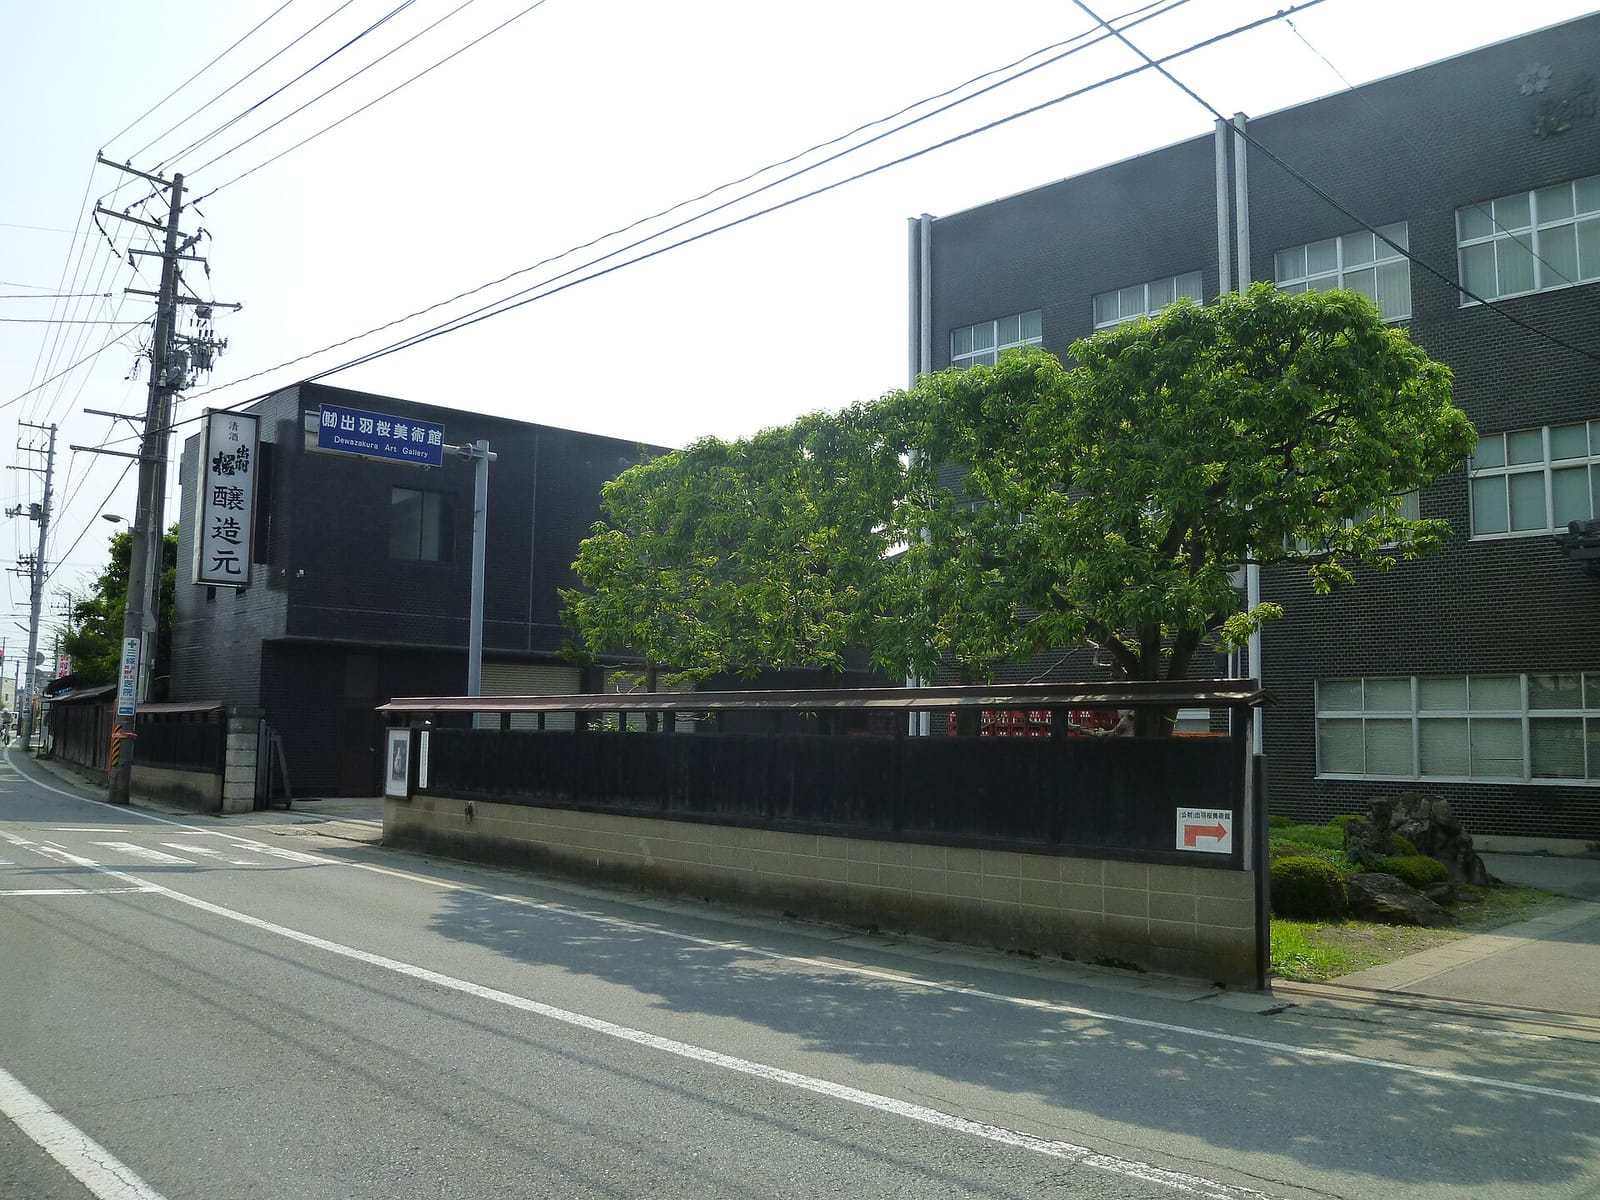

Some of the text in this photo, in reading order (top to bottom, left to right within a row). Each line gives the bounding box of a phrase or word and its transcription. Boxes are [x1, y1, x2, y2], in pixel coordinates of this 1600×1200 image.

[228, 421, 239, 442] 清酒
[334, 435, 429, 459] Dewazakura Art Gallery
